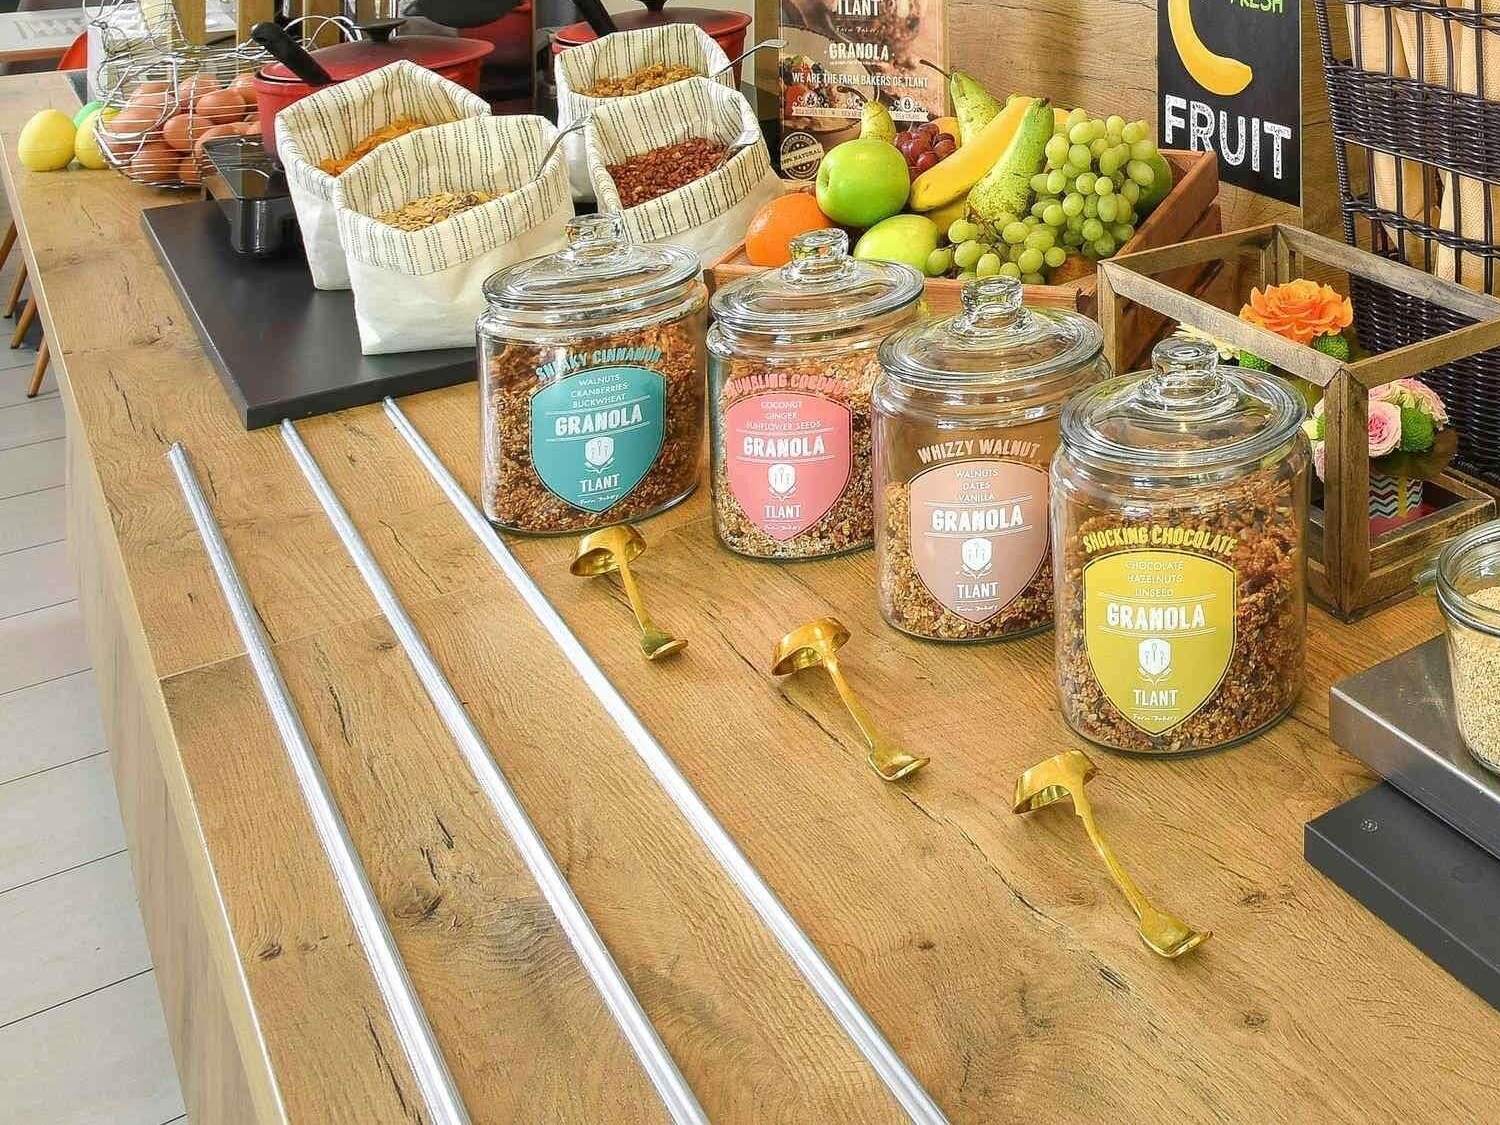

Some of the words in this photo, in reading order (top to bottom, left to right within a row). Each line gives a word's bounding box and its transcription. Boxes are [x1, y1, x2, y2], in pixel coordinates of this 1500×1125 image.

[829, 43, 889, 61] GRANOLA
[792, 72, 805, 83] WE
[806, 73, 821, 83] ARE
[823, 73, 837, 84] THE
[838, 74, 859, 85] FARM
[861, 75, 891, 86] BAKERS
[893, 76, 903, 86] OF
[904, 76, 928, 87] TLANT
[1164, 94, 1292, 179] FRUIT
[579, 374, 620, 386] WALNUTS
[571, 382, 629, 398] CRANBERRIES
[573, 393, 626, 408] BUCKWHEAT
[761, 401, 802, 409] COCONUT
[555, 404, 643, 436] GRANOLA
[766, 412, 797, 420] GINGER
[745, 421, 792, 431] SUNFLOWER
[796, 420, 821, 430] SEEDS
[743, 436, 825, 458] GRANOLA
[917, 439, 974, 464] WHIZZY
[979, 439, 1041, 459] WALNUT
[955, 468, 999, 479] WALNUTS
[579, 474, 621, 493] TLANT
[962, 481, 991, 491] DATES
[959, 492, 996, 502] VANILLA
[764, 504, 801, 519] TLANT
[932, 505, 1024, 532] GRANOLA
[1083, 526, 1149, 554] SHOCKING
[1151, 525, 1238, 556] CHOCOLATE
[1126, 562, 1184, 571] CHOCOLATE
[1128, 574, 1183, 584] HAZELNUTS
[956, 582, 999, 599] TLANT
[1135, 588, 1174, 597] LINSEED
[1107, 603, 1206, 631] GRANOLA
[1133, 689, 1178, 707] TLANT
